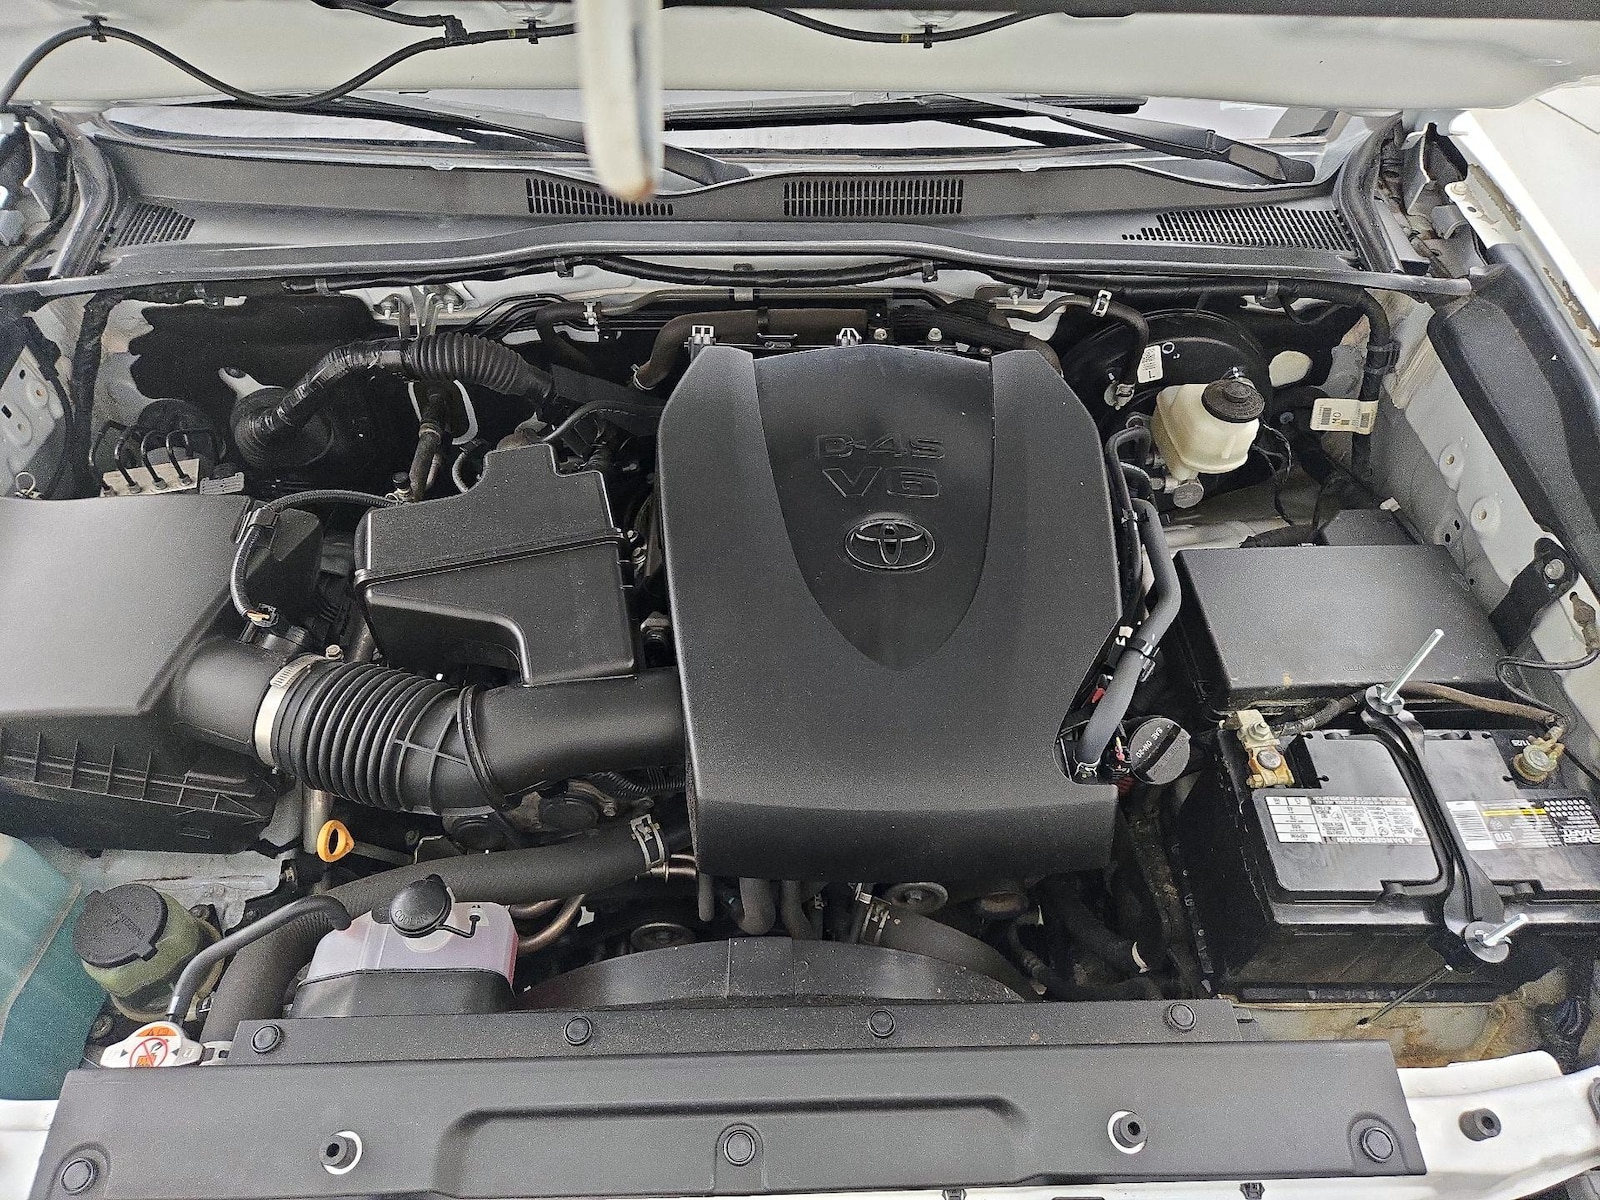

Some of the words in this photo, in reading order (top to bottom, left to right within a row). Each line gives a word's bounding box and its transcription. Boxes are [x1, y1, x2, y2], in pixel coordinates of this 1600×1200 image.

[822, 466, 940, 498] V6
[1150, 727, 1163, 741] SAE
[1563, 835, 1600, 844] SUPER
[394, 907, 435, 927] COOLANT
